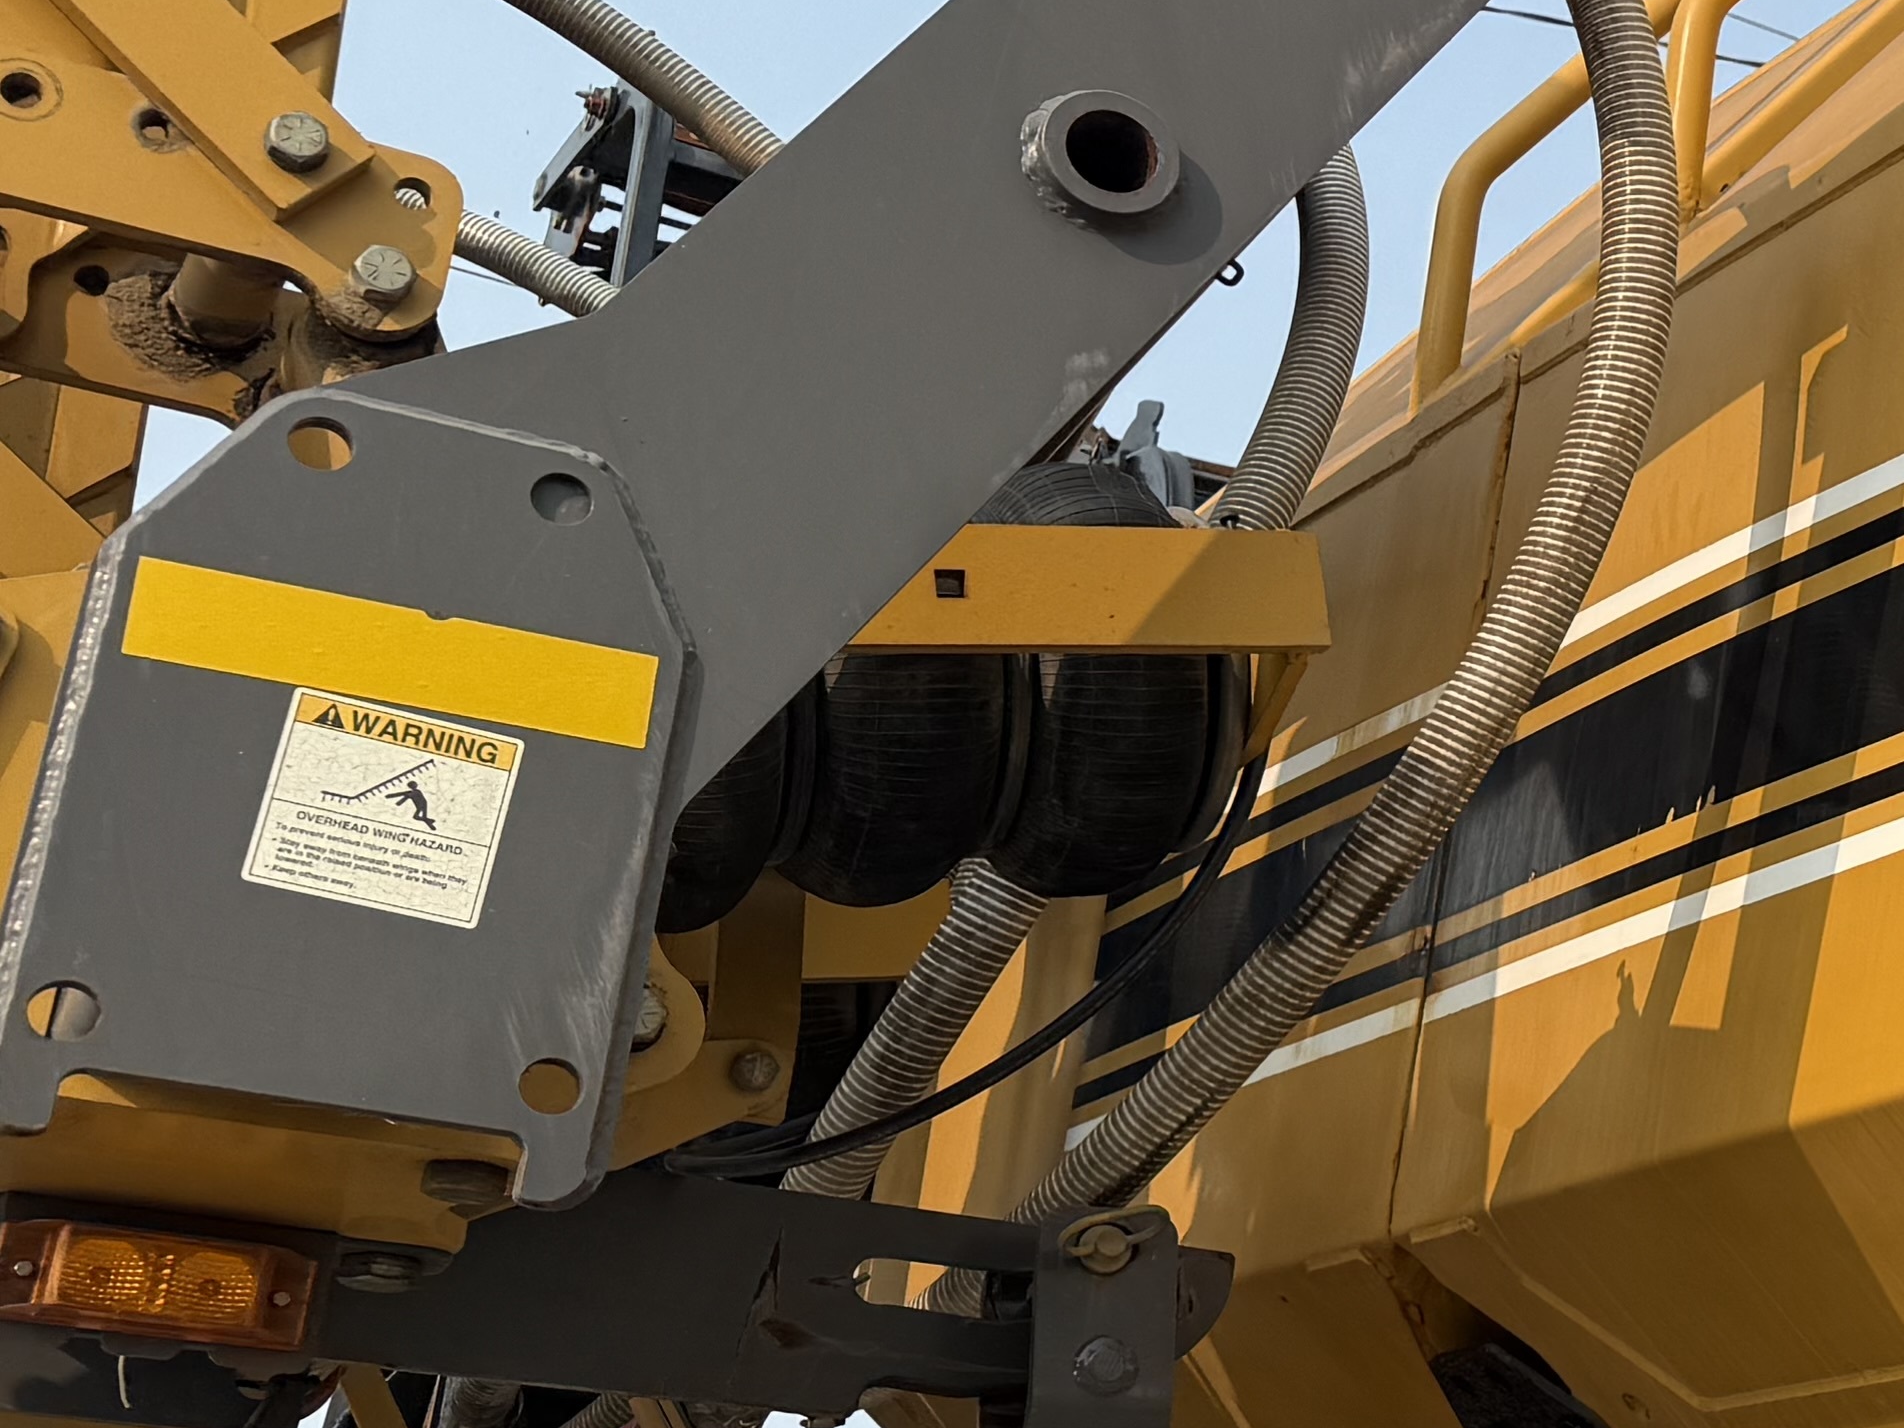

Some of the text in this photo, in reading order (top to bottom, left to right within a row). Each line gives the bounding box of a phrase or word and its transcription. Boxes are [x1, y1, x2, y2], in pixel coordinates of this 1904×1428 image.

[351, 710, 499, 764] WARNING
[296, 809, 463, 855] OVERHEAD WING HAZARD
